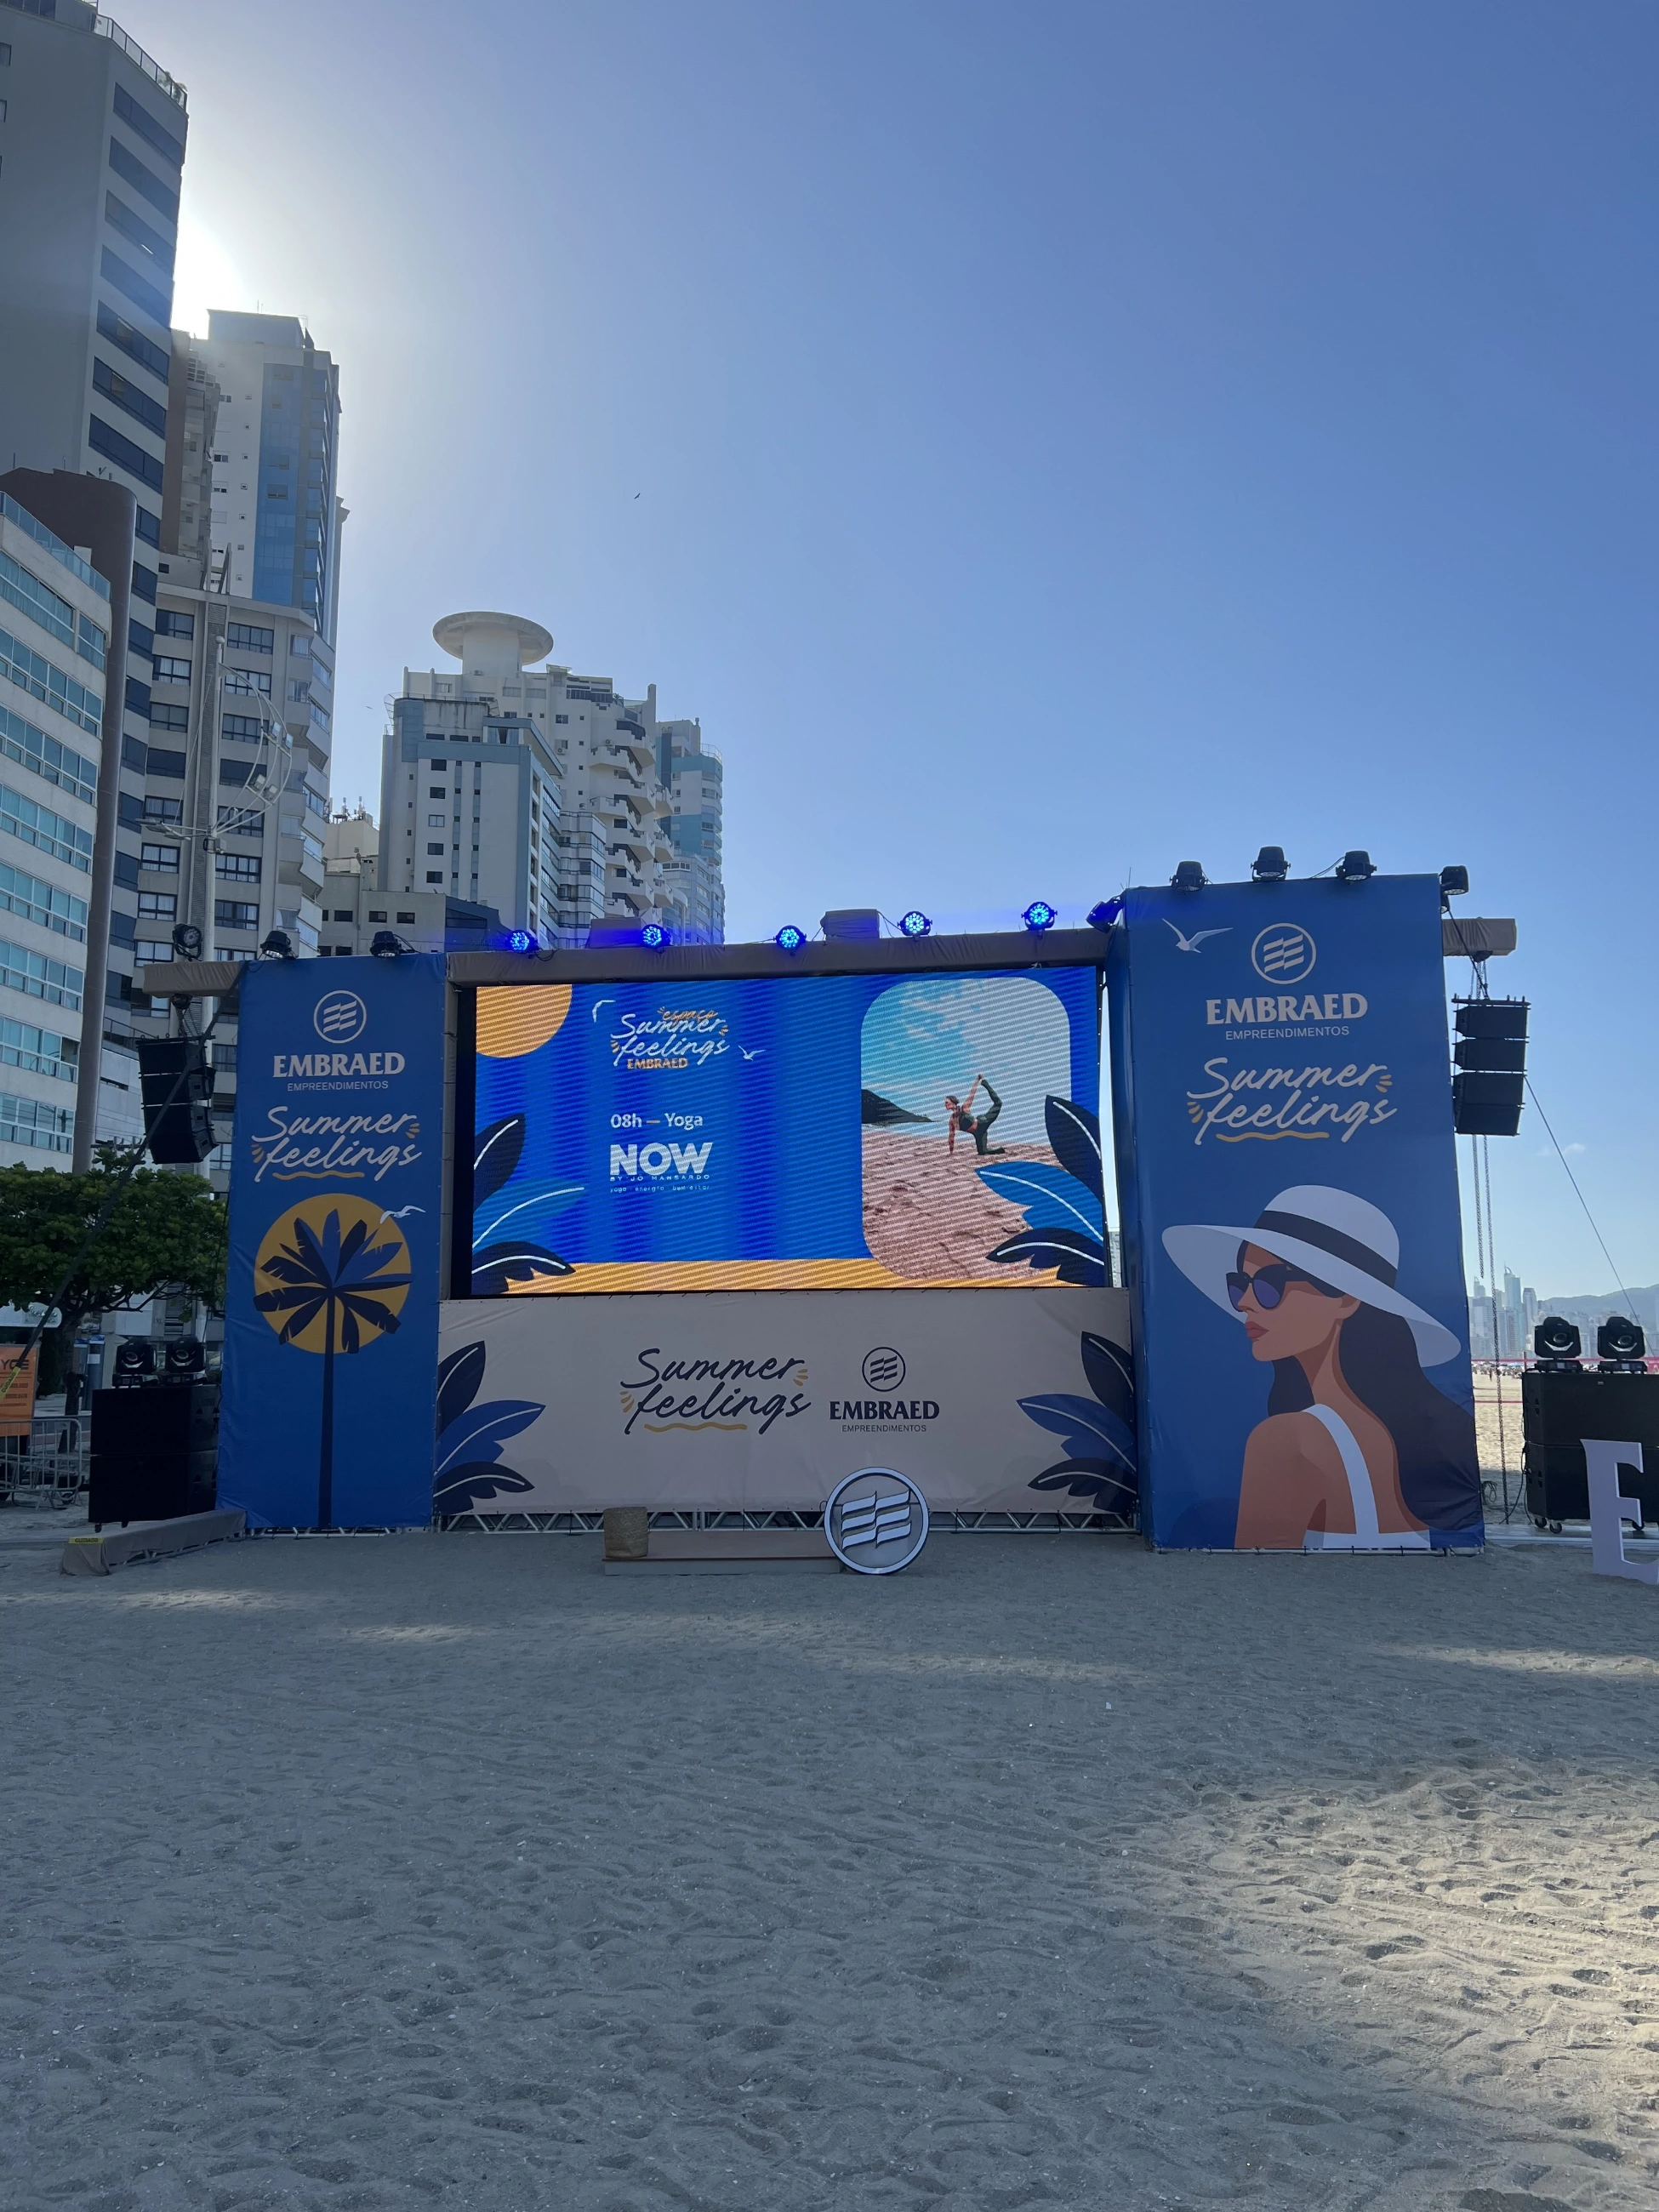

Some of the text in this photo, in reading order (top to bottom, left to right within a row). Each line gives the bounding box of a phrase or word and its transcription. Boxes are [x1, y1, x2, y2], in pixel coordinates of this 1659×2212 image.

[1206, 993, 1368, 1024] EMBRAED
[611, 1013, 727, 1040] Summer
[1225, 1026, 1349, 1040] EMPREENDIMENTOS
[272, 1052, 406, 1078] EMBRAED
[613, 1034, 731, 1067] feelings
[626, 1058, 688, 1069] EMBRAED
[287, 1080, 389, 1092] EMPREENDIMENTOS
[1187, 1058, 1388, 1099] Summer
[251, 1106, 417, 1142] Summer
[610, 1113, 642, 1128] 08h
[664, 1113, 703, 1131] Yoga
[1194, 1089, 1398, 1145] feelings
[254, 1135, 422, 1183] feelings
[610, 1142, 713, 1176] NOW
[620, 1348, 805, 1388] Summer
[624, 1382, 812, 1434] feelings
[829, 1400, 940, 1421] EMBRAED
[841, 1424, 927, 1433] EMPREENDIMENTOS
